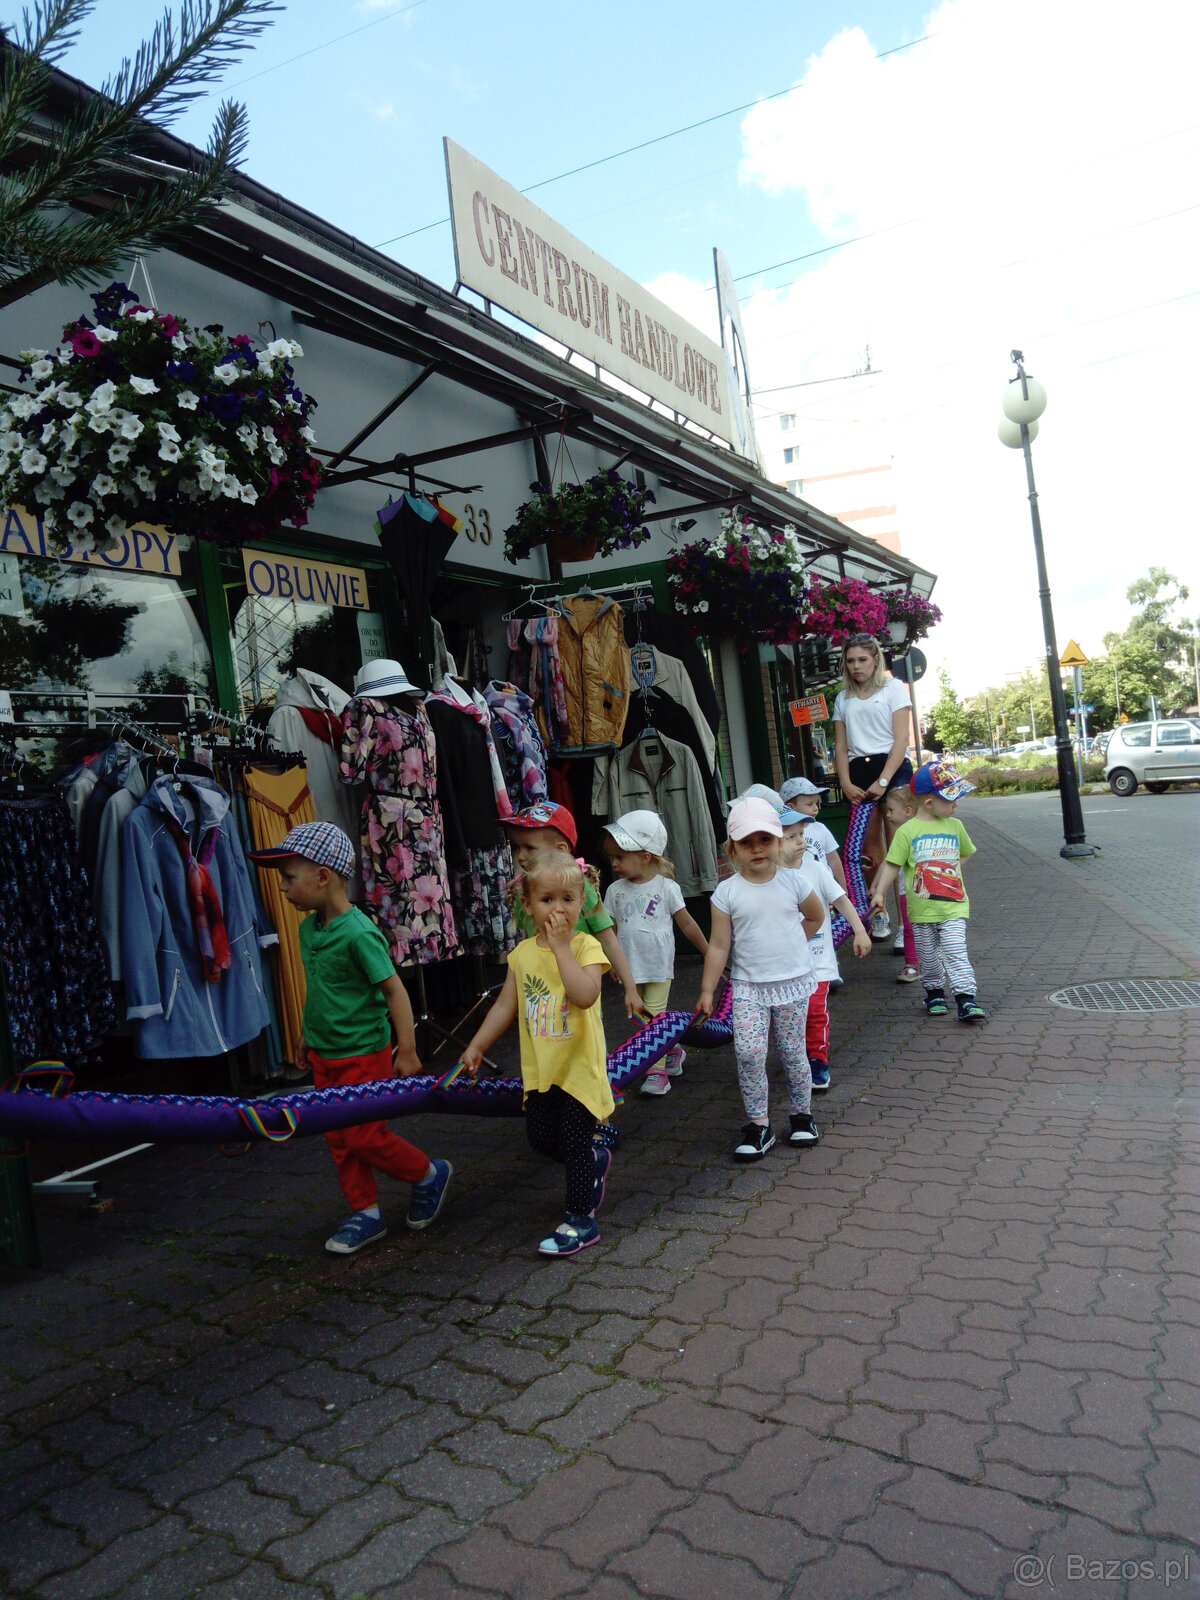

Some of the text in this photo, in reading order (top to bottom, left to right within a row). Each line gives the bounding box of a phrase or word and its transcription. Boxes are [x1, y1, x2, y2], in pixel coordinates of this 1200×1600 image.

[472, 190, 722, 415] CENTRUM HANDLOWE
[465, 504, 493, 546] 33
[249, 560, 364, 608] OBUWIE
[793, 696, 821, 709] OTWARTE
[916, 837, 957, 851] FIREBALL
